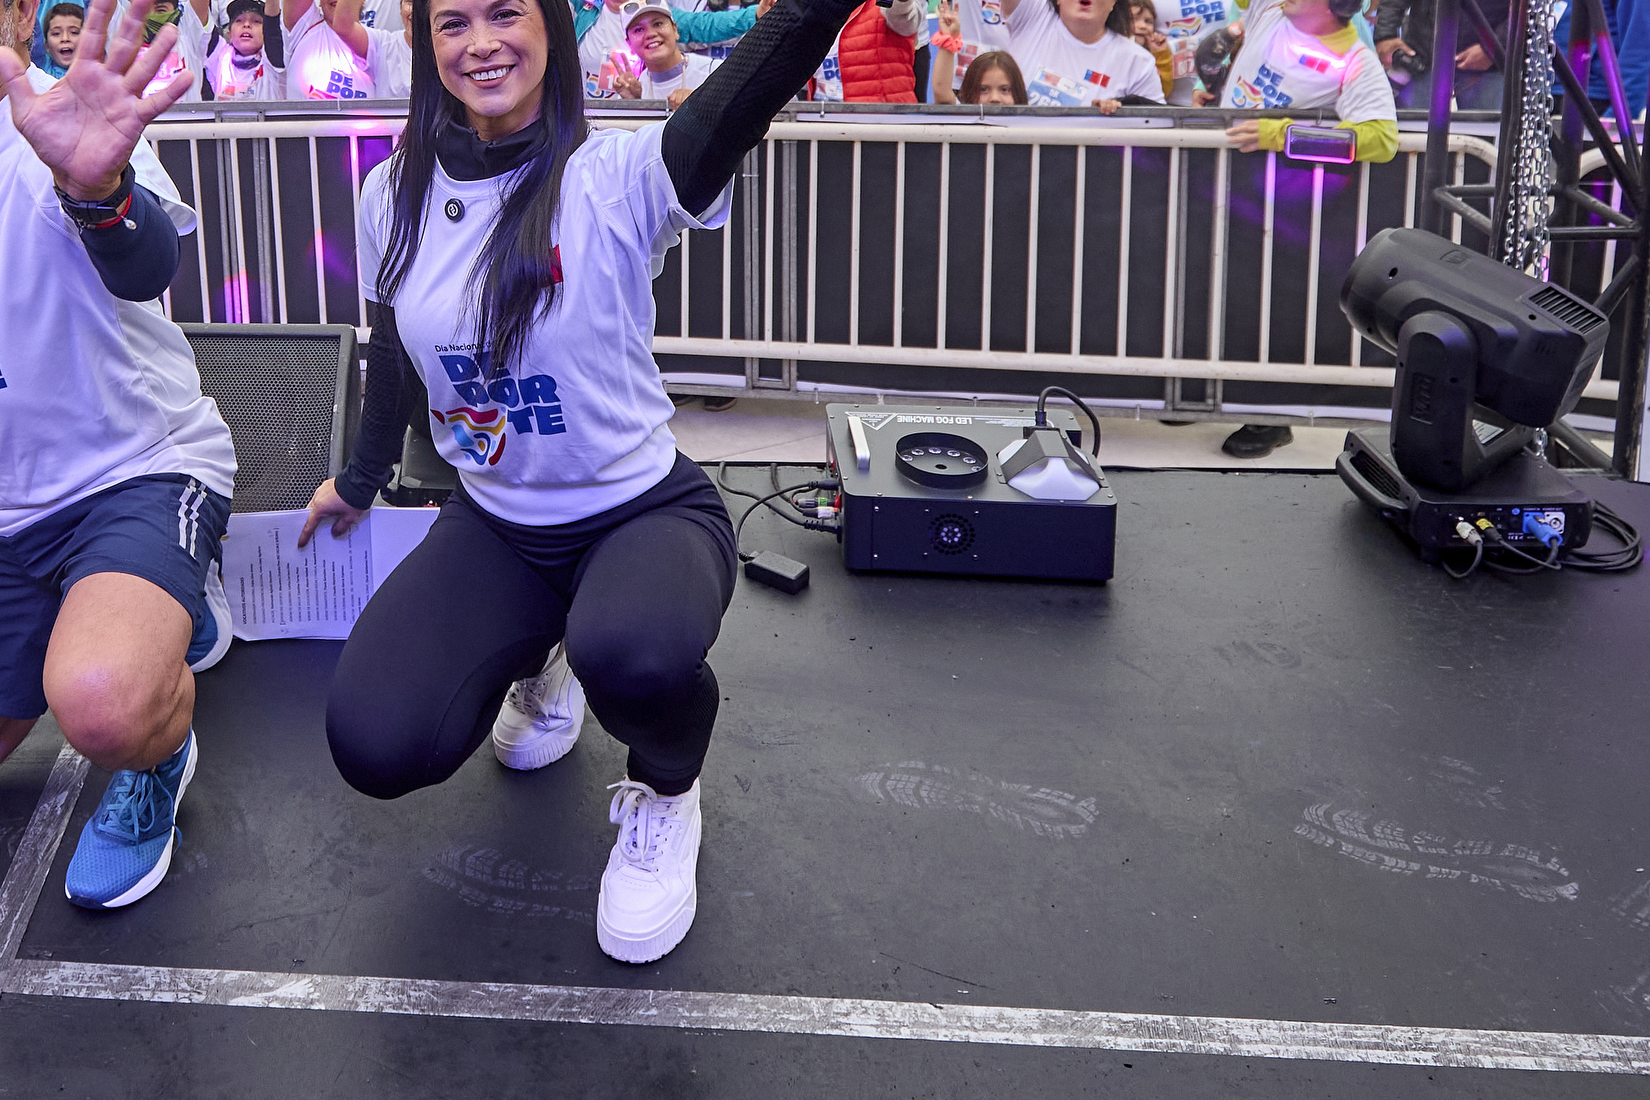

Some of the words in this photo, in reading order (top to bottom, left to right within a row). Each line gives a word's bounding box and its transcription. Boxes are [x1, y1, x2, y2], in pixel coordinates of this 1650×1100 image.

[1181, 1, 1223, 18] POR
[1202, 10, 1226, 24] TE
[331, 71, 353, 87] DE
[824, 69, 842, 81] PO
[1258, 64, 1285, 87] DE
[435, 343, 450, 352] Día
[452, 374, 558, 409] POR
[507, 404, 567, 436] TE
[896, 415, 935, 424] MACHINE
[936, 416, 954, 424] FOG
[955, 417, 973, 425] LED
